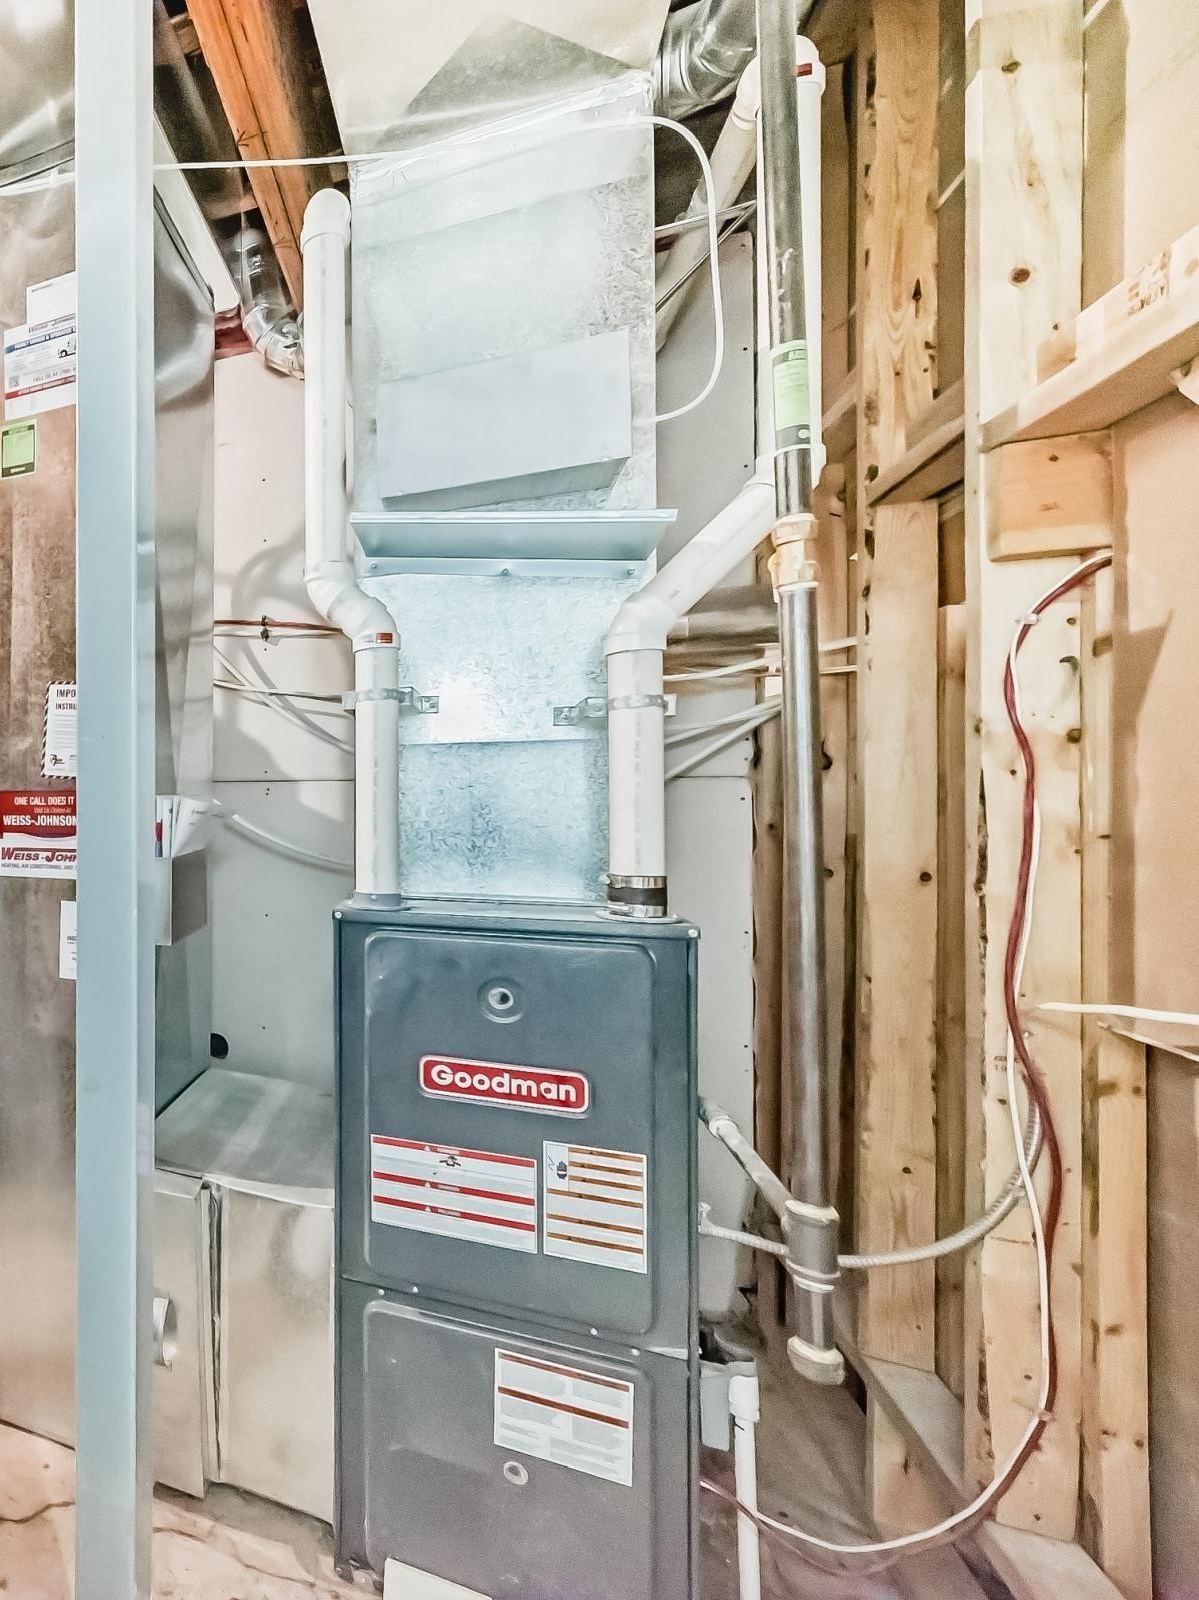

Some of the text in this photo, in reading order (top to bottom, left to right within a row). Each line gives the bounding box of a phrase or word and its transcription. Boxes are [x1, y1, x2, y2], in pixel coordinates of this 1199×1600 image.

[14, 796, 75, 806] ONE CALL DOES IT
[430, 1064, 577, 1103] Goodman
